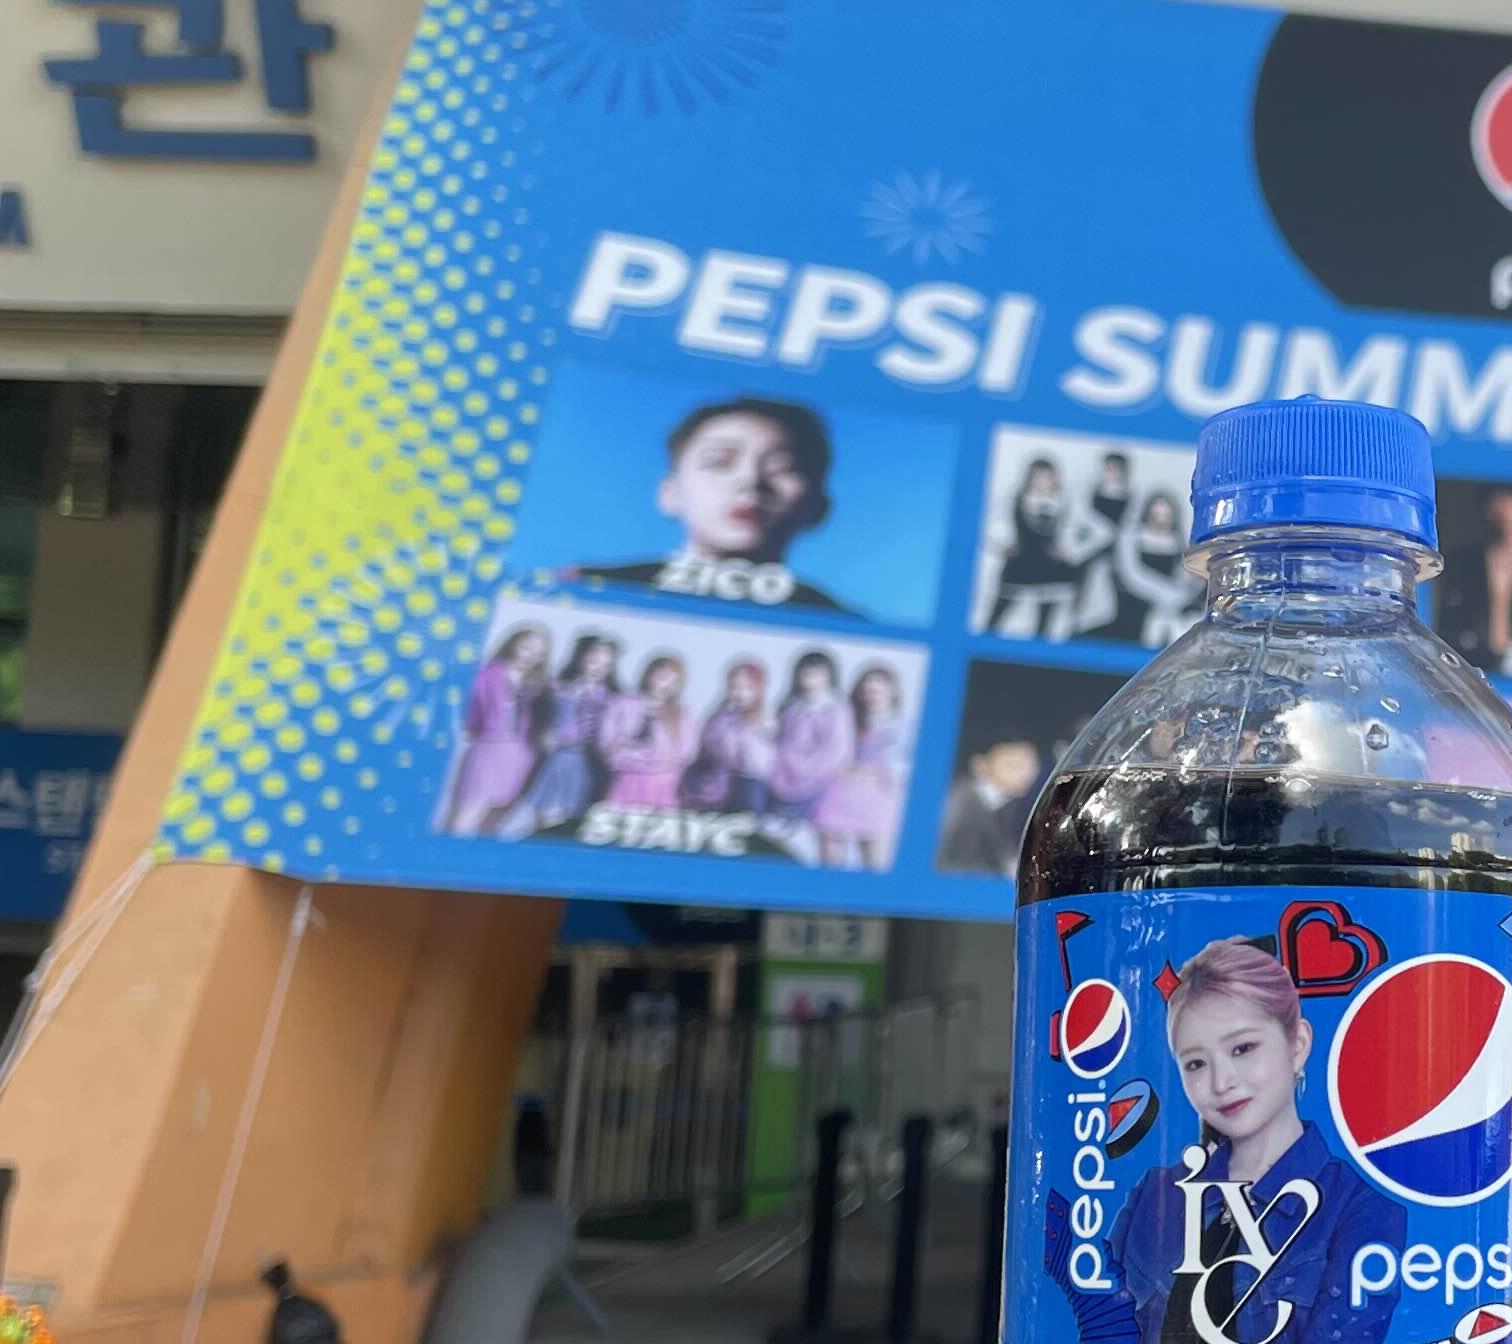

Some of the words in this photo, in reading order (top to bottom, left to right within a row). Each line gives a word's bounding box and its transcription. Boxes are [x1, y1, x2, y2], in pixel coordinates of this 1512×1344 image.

[569, 229, 1036, 393] PEPSI
[656, 553, 797, 606] ZICO
[577, 802, 756, 857] STAYC
[1068, 1091, 1116, 1290] pepsi
